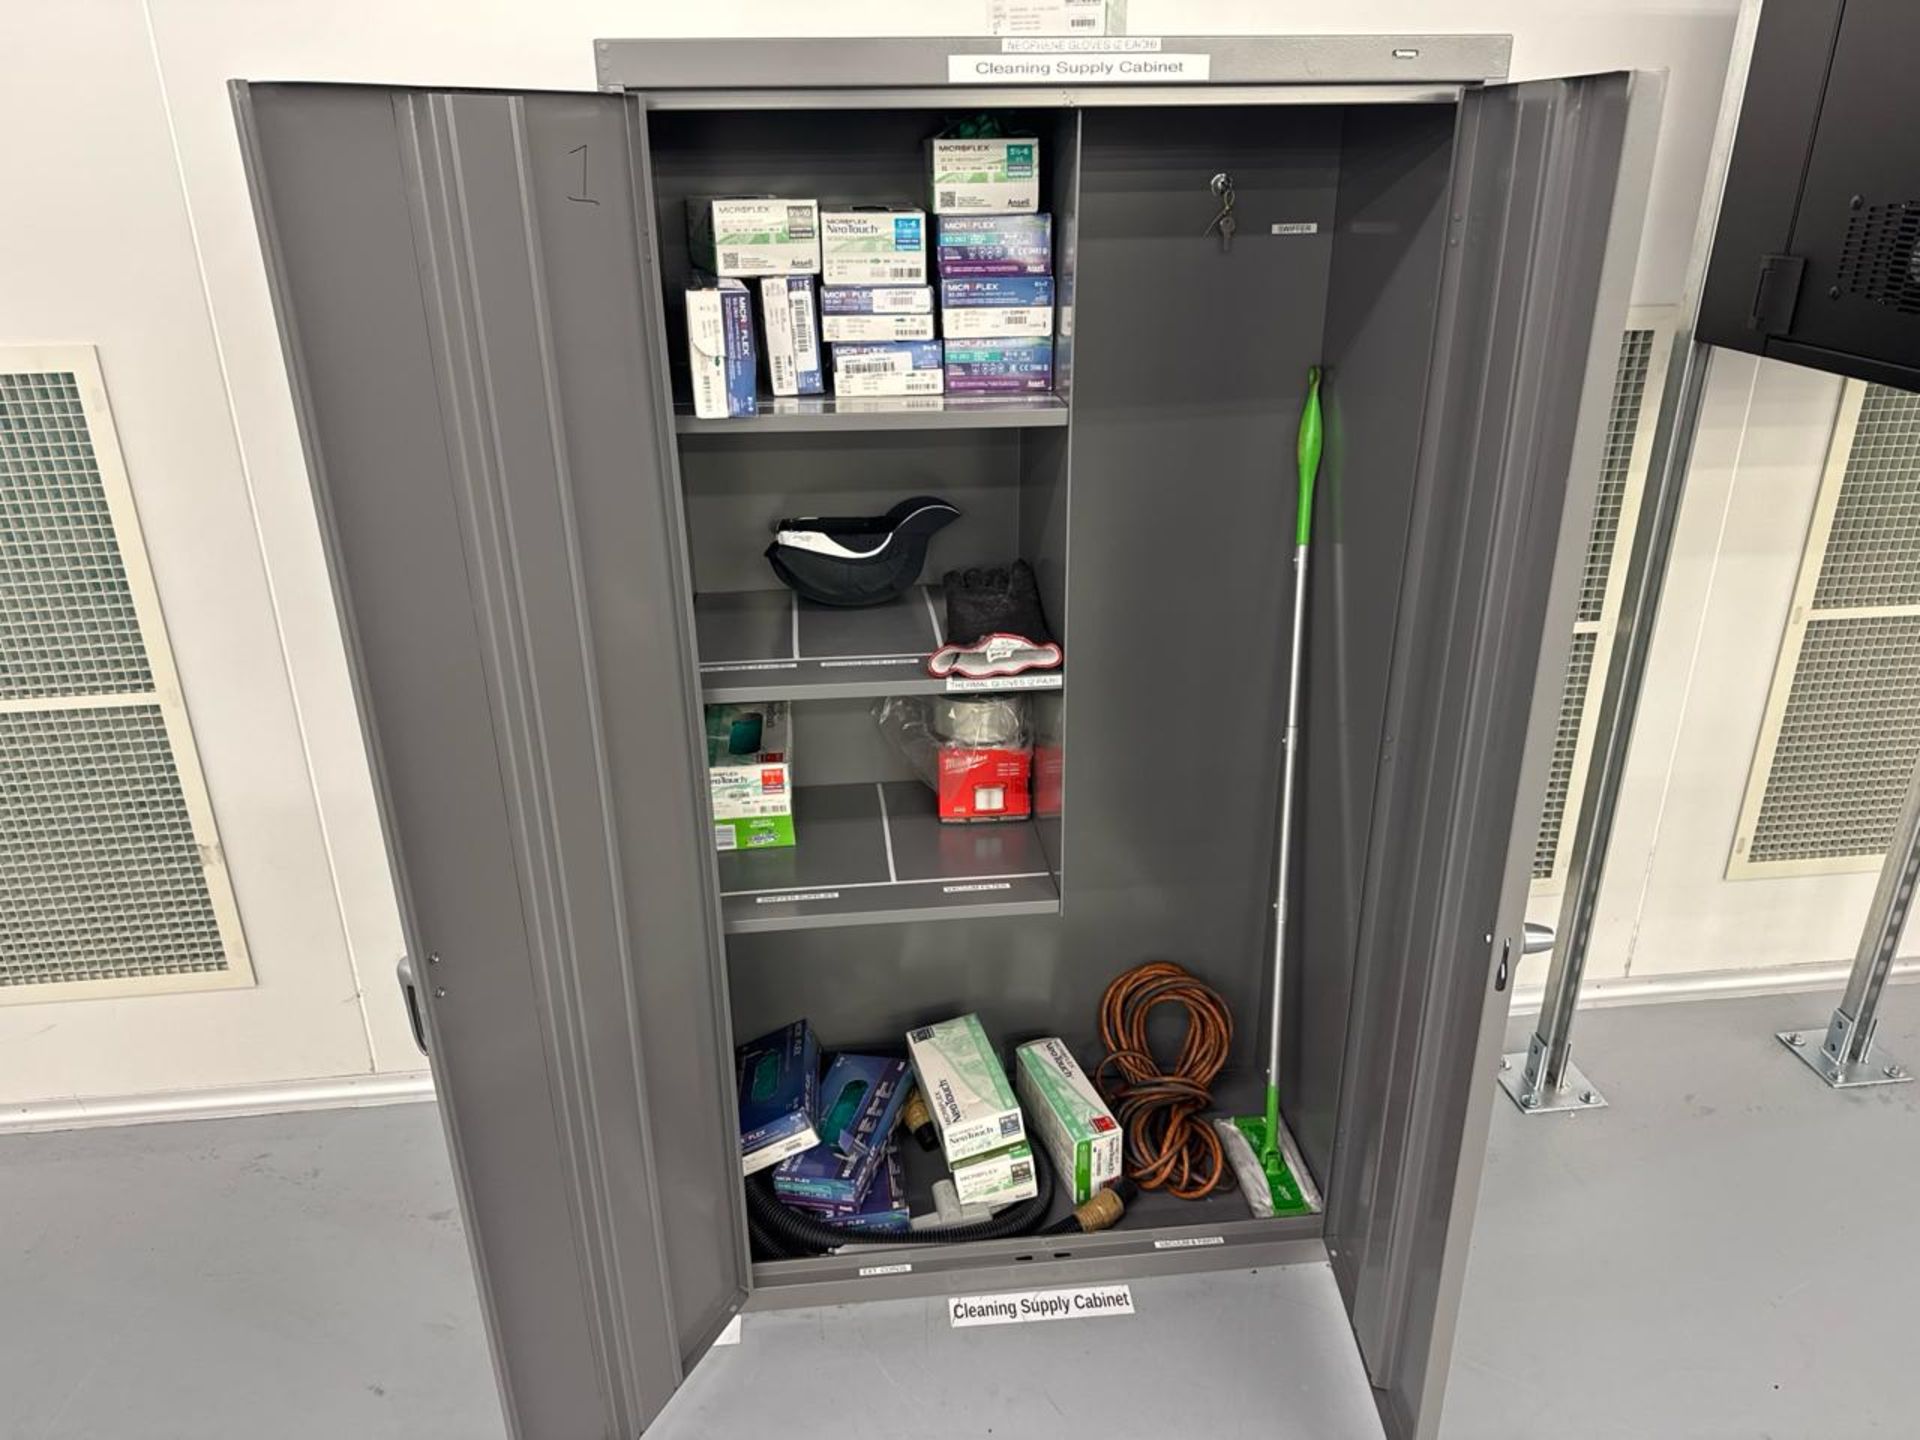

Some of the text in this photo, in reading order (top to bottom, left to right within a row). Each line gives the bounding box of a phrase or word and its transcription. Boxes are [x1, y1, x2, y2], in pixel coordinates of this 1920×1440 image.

[976, 61, 1183, 75] Cleaning Supply Cabinet
[826, 225, 879, 234] NeoTouch
[939, 1080, 961, 1123] NeoTouch
[953, 1292, 1130, 1319] Cleaning Supply Cabinet
